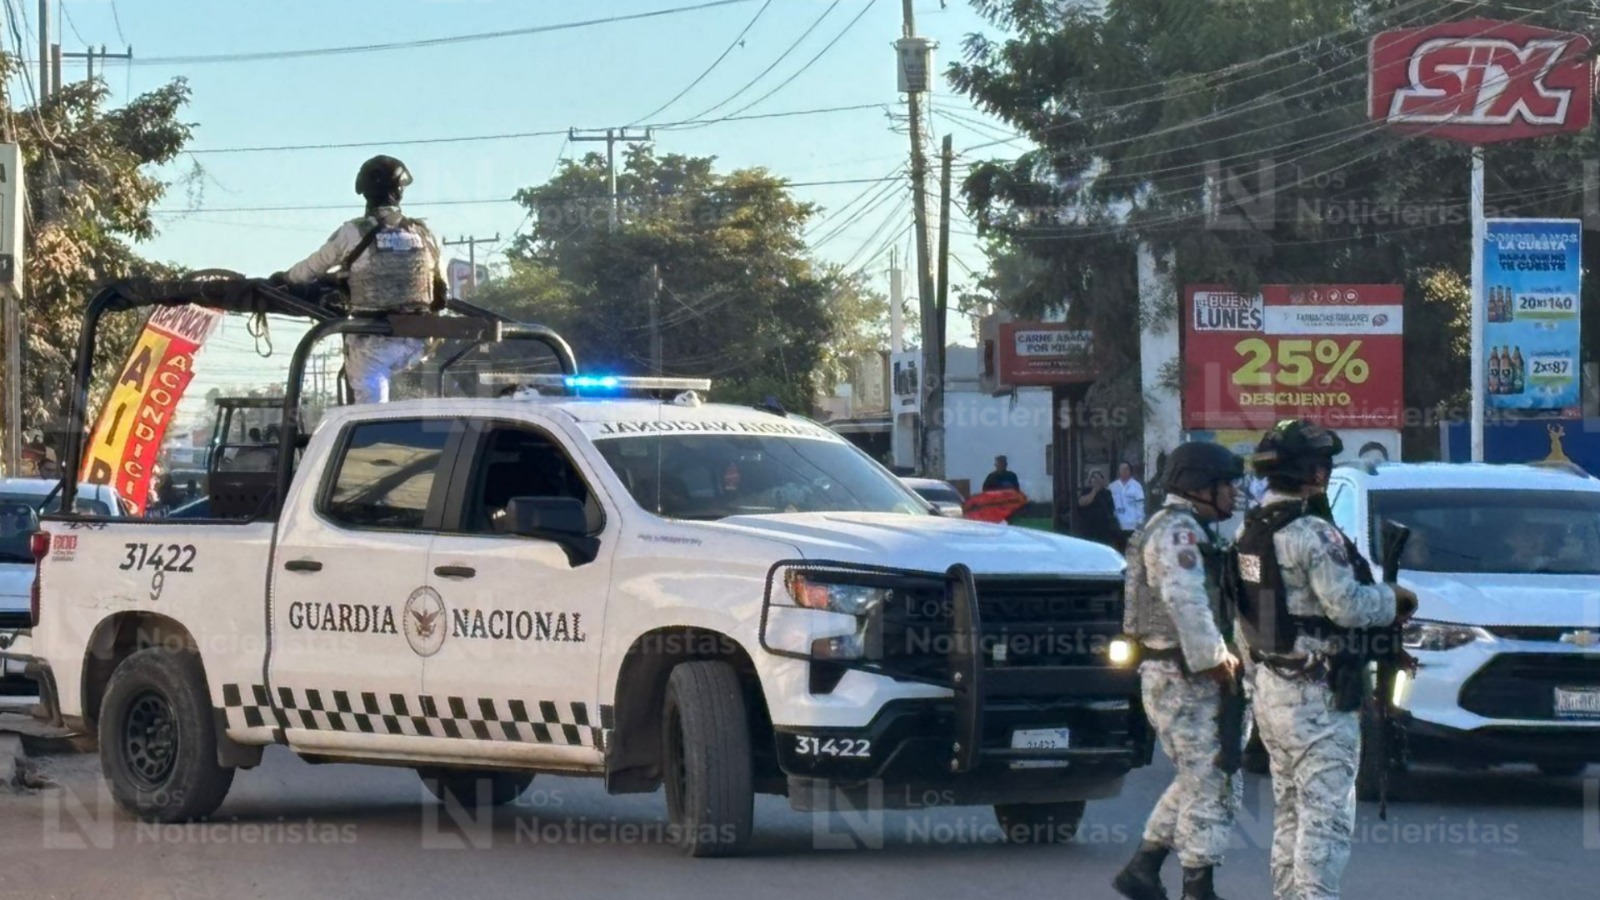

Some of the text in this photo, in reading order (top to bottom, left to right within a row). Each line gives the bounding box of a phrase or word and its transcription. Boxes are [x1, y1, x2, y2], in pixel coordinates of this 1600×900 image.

[1387, 38, 1571, 124] SIX
[1232, 337, 1369, 386] 25%
[1239, 392, 1351, 406] DESCUENTO
[119, 542, 197, 573] 31422
[289, 601, 586, 643] GUARDIA NACIONAL
[795, 735, 871, 758] 31422
